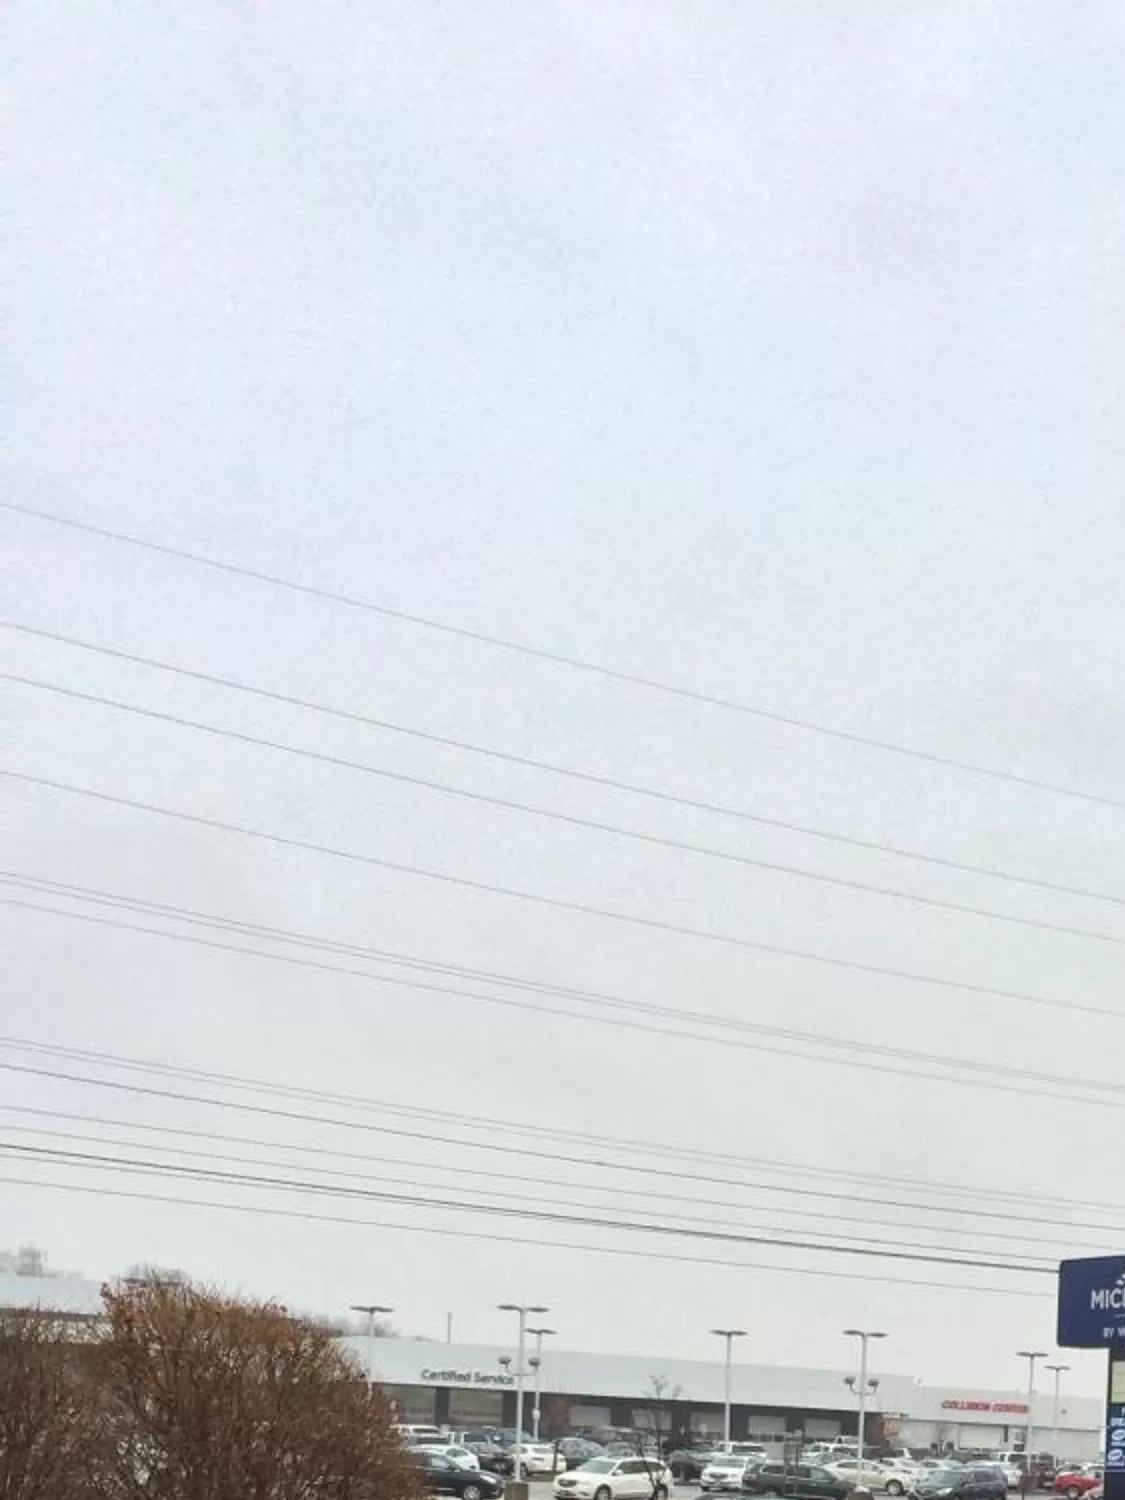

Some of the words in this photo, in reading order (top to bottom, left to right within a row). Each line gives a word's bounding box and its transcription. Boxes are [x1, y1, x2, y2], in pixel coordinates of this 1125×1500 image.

[1103, 1327, 1115, 1338] BY
[421, 1368, 471, 1382] Certified
[474, 1371, 515, 1385] Service
